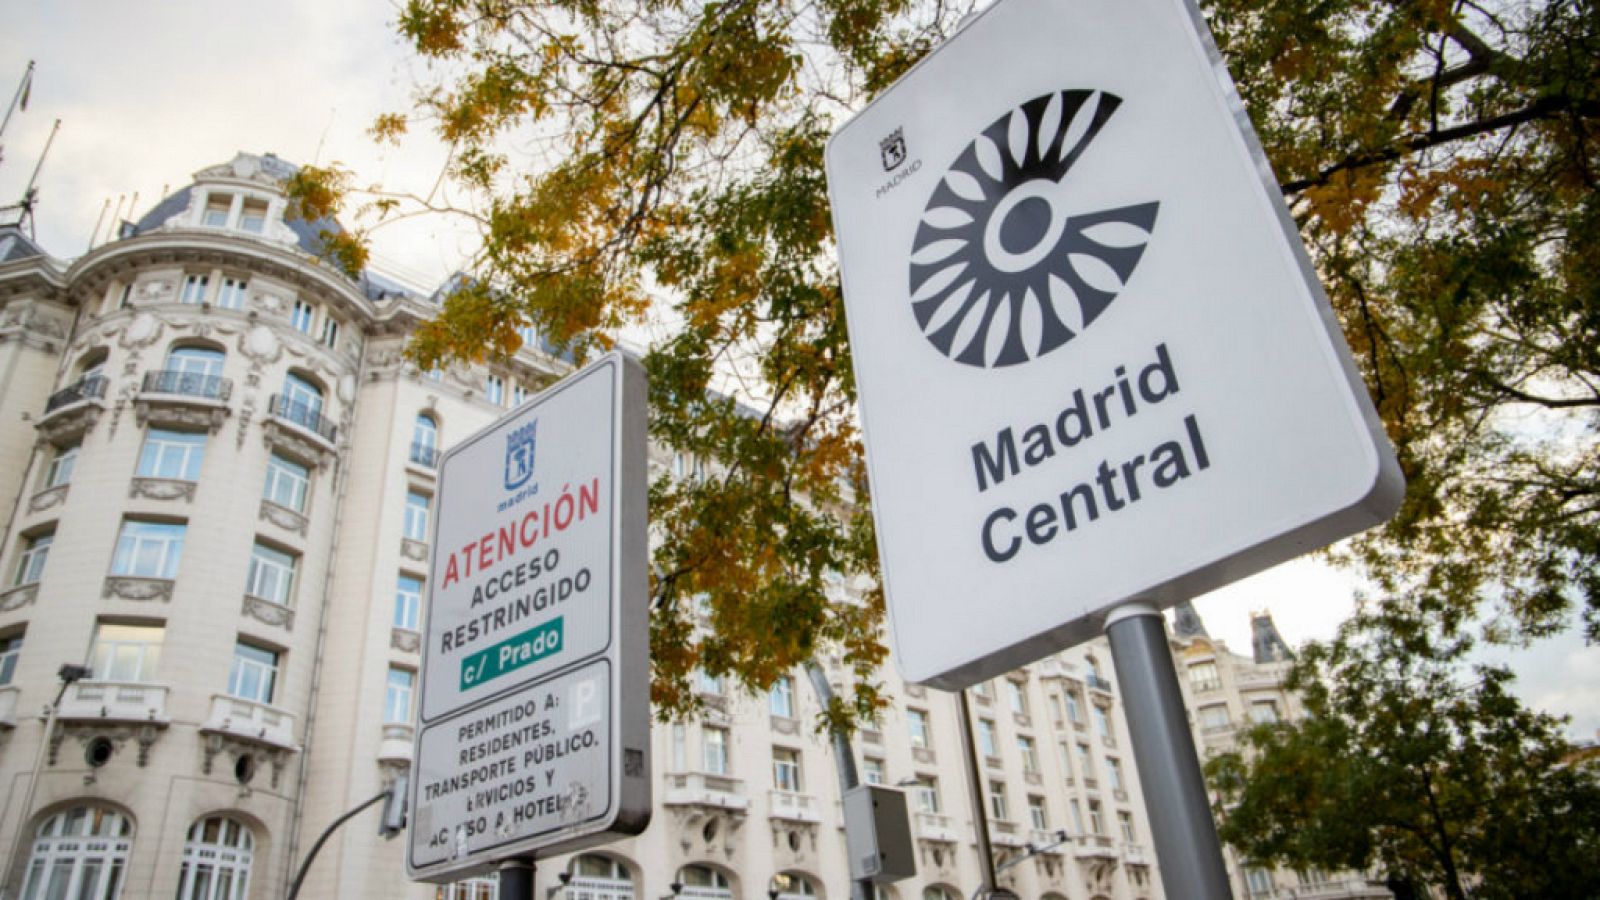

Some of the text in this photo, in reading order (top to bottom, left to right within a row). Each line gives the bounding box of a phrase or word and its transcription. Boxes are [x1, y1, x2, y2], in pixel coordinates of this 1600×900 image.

[877, 159, 923, 198] MADRID
[971, 342, 1180, 493] Madrid
[497, 483, 539, 512] madrid
[981, 414, 1210, 563] Central
[441, 477, 599, 590] ATENCIÓN
[470, 548, 559, 608] ACCESO
[440, 567, 592, 654] RESTRINGIDO
[464, 627, 559, 684] c/ Prado
[457, 693, 559, 742] PERMITIDO A:
[459, 719, 556, 766] RESIDENTES.
[425, 729, 599, 801] TRANSPORTE PÚBLICO.
[545, 768, 555, 787] Y
